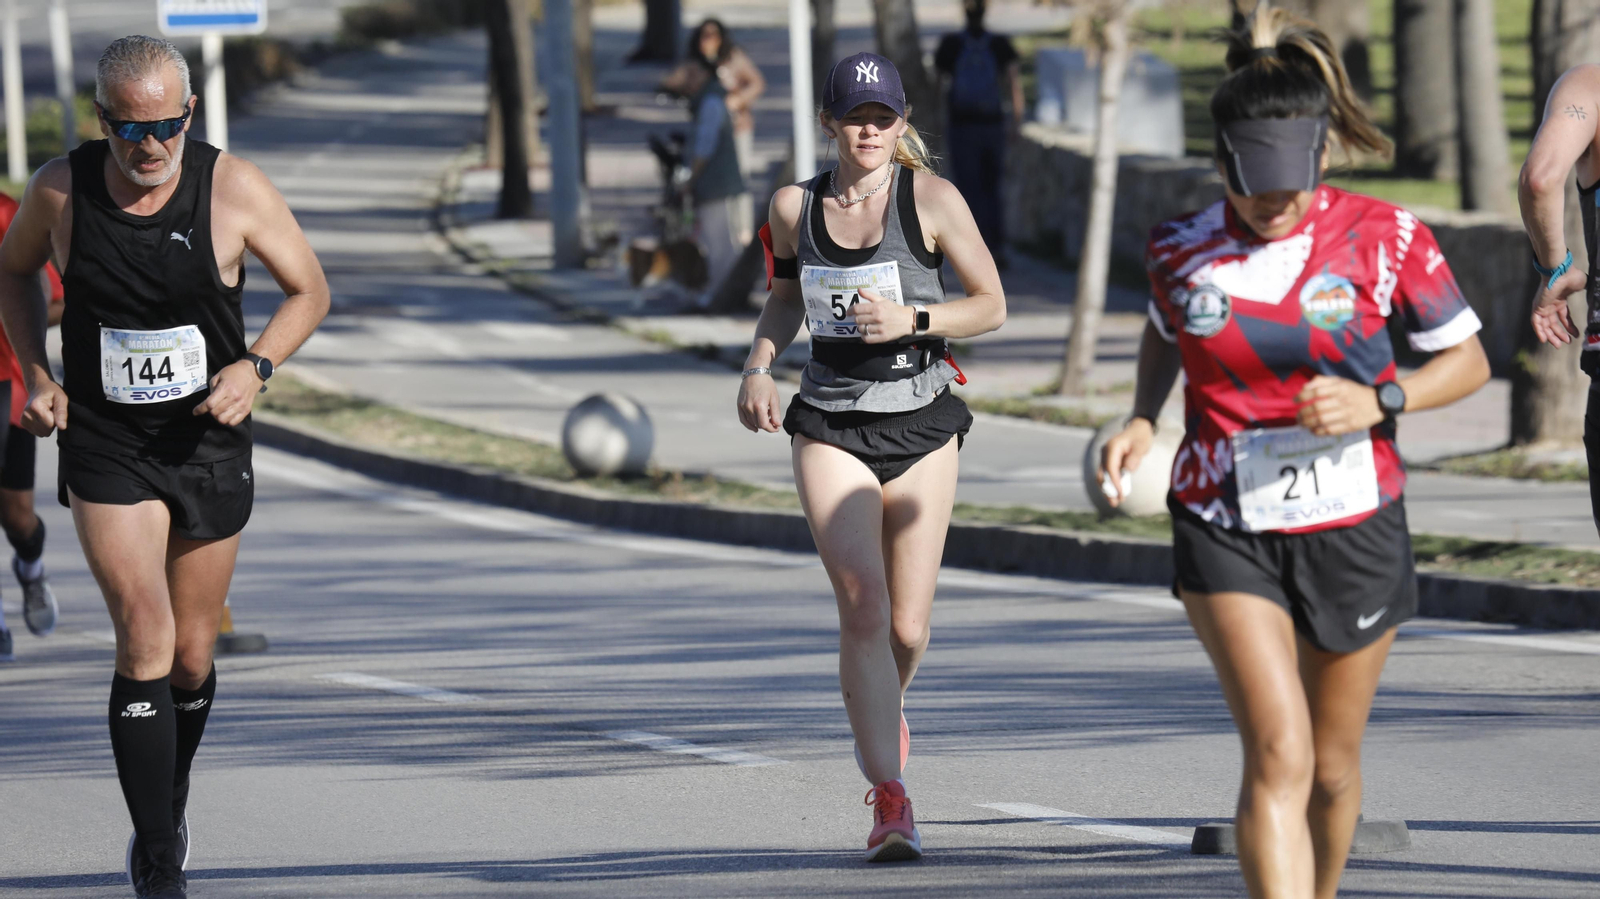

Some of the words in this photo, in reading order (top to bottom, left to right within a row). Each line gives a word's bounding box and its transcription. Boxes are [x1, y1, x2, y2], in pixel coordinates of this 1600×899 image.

[855, 61, 879, 83] NY
[827, 275, 869, 286] MARATÓN
[128, 337, 173, 349] MARATÓN
[122, 356, 174, 385] 144
[130, 387, 182, 401] EVOS
[1279, 460, 1320, 501] 21
[1283, 502, 1345, 520] EVOS
[131, 709, 157, 718] SPORT
